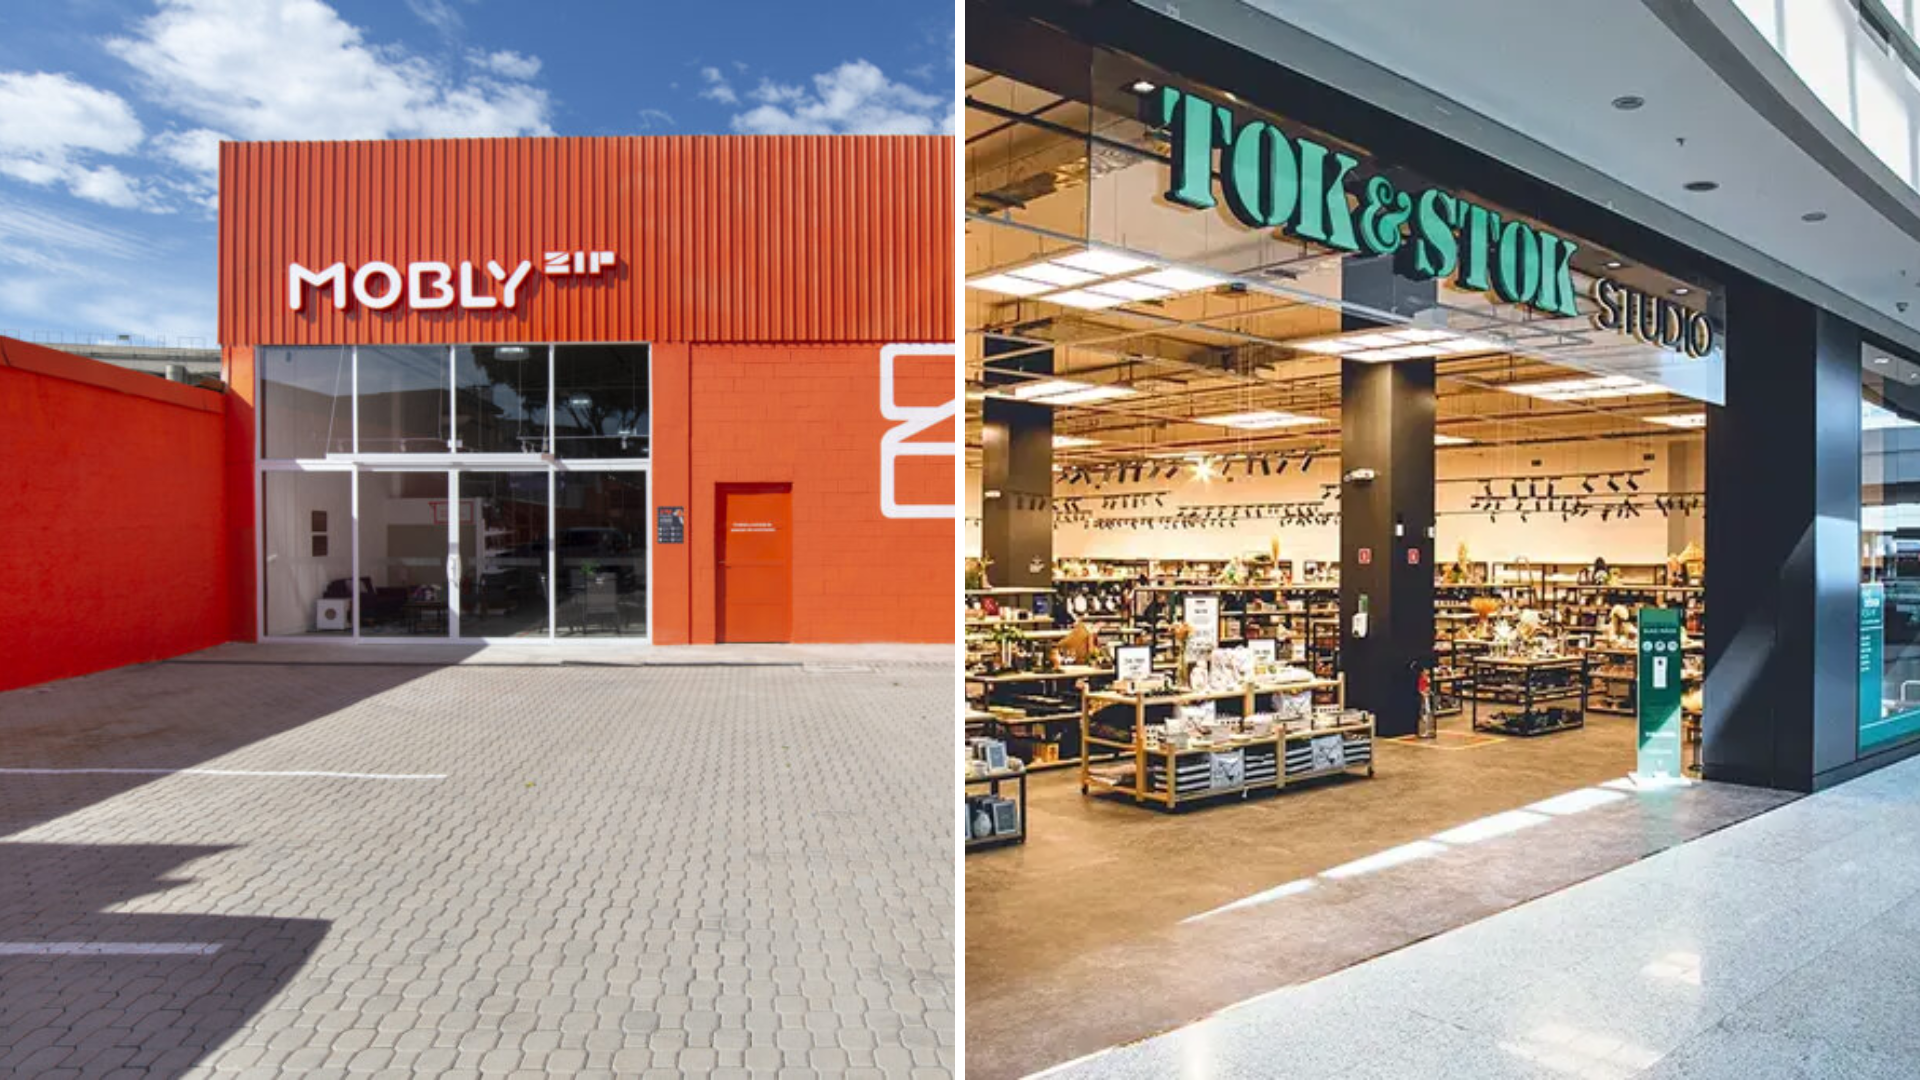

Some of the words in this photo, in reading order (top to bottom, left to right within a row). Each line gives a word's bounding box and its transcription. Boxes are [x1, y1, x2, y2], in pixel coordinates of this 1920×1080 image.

[1160, 86, 1579, 318] TOK&STOK
[288, 259, 532, 310] MOBLY
[543, 250, 616, 275] ZIP
[1592, 277, 1713, 358] STUDIO
